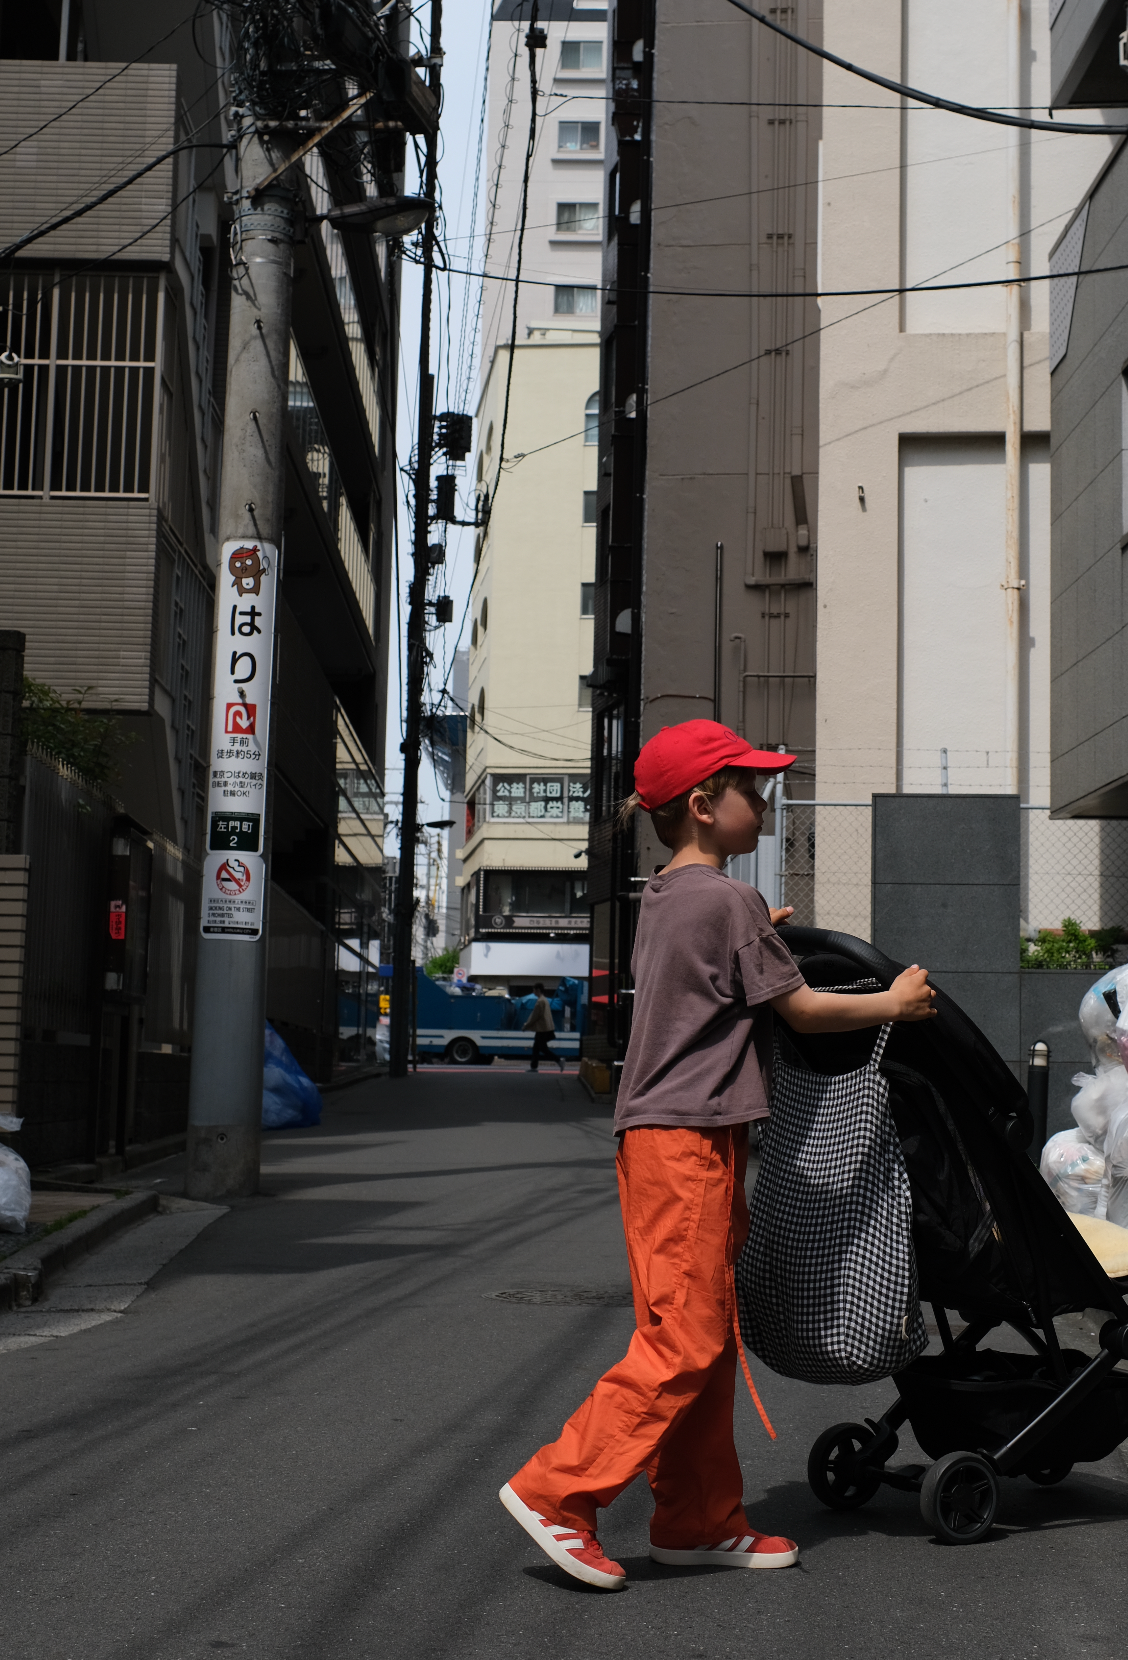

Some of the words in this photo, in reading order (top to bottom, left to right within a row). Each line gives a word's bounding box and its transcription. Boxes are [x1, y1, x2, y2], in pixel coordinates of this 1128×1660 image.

[230, 604, 262, 683] はり
[229, 736, 249, 747] 手前
[216, 749, 261, 761] 徒歩約5分
[212, 770, 263, 781] 東京つばめ鍼灸
[216, 820, 253, 833] 左門町
[229, 835, 238, 847] 2
[216, 880, 223, 889] NO
[222, 881, 250, 895] SMOKING
